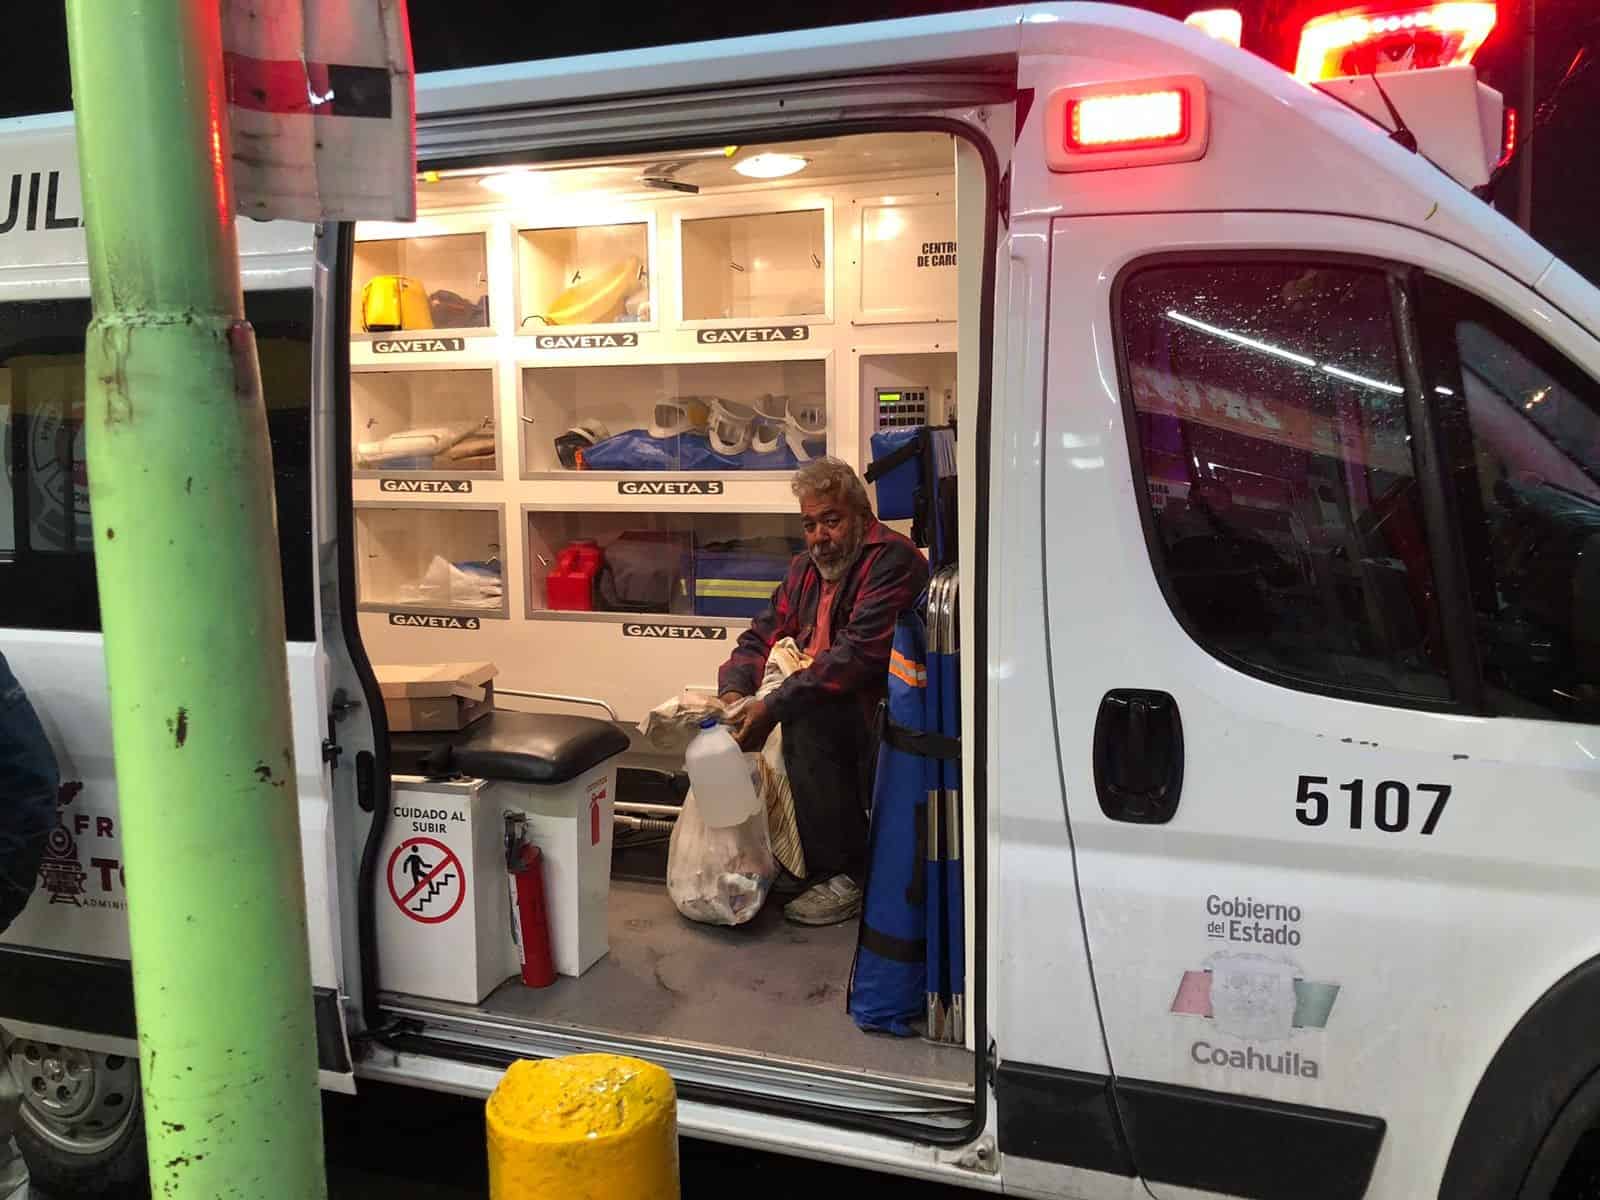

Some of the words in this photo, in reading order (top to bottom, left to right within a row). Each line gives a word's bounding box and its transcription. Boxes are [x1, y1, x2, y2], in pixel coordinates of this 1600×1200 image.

[917, 255, 930, 267] DE
[539, 335, 618, 349] GAVETA
[622, 334, 635, 347] 2
[701, 328, 787, 343] GAVETA
[791, 327, 805, 340] 3
[375, 340, 445, 353] GAVETA
[451, 339, 460, 350] 1
[383, 480, 454, 493] GAVETA
[457, 481, 470, 493] 4
[622, 482, 702, 494] GAVETA
[707, 482, 720, 494] 5
[392, 614, 462, 628] GAVETA
[466, 617, 478, 629] 6
[626, 625, 705, 639] GAVETA
[710, 627, 722, 639] 7
[1295, 775, 1452, 835] 5107
[393, 807, 448, 820] CUIDADO
[451, 811, 467, 822] AL
[412, 821, 448, 834] SUBIR
[90, 856, 126, 892] T
[1206, 894, 1301, 922] Gobierno
[1207, 920, 1225, 935] del
[1229, 920, 1301, 946] Estado
[1191, 1041, 1319, 1079] Coahuila
